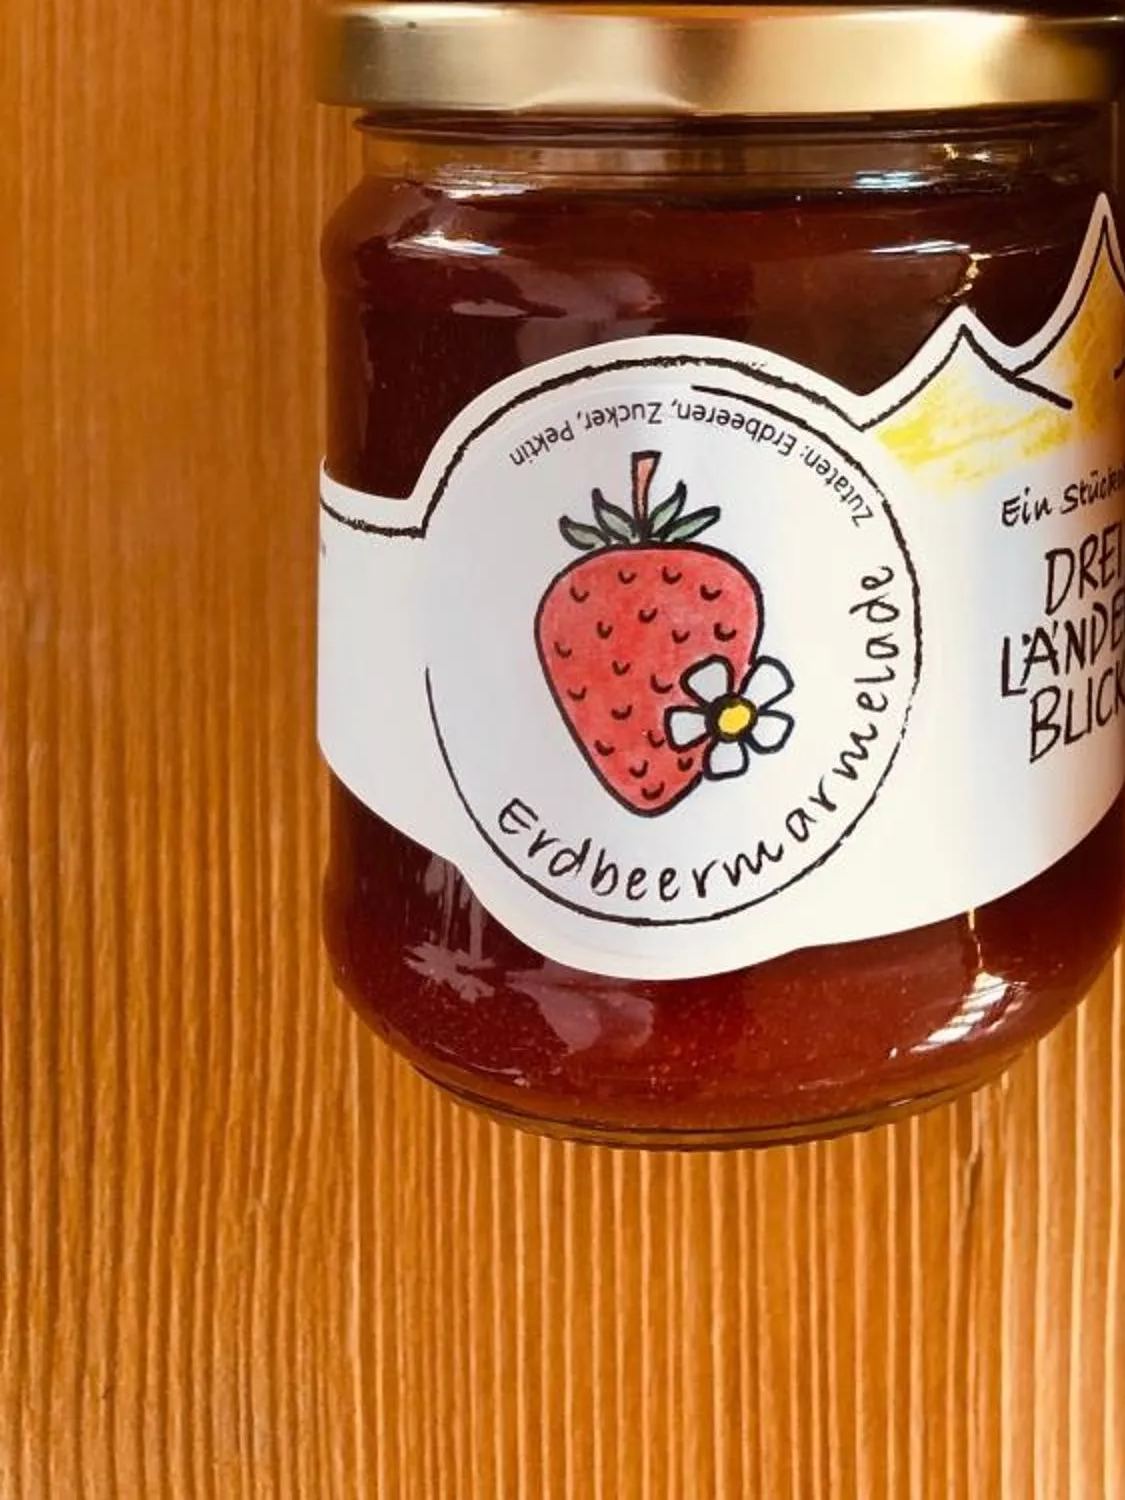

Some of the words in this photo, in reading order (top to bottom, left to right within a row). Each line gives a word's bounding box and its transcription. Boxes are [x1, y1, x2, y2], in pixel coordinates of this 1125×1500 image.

[576, 400, 663, 431] Zucker,
[671, 397, 799, 458] Erdbeeren,
[509, 426, 575, 468] Pektin
[798, 447, 875, 528] Zutaten:
[1001, 486, 1053, 528] Ein
[1044, 520, 1122, 617] DREI
[498, 565, 900, 902] Erdbeermarmelade
